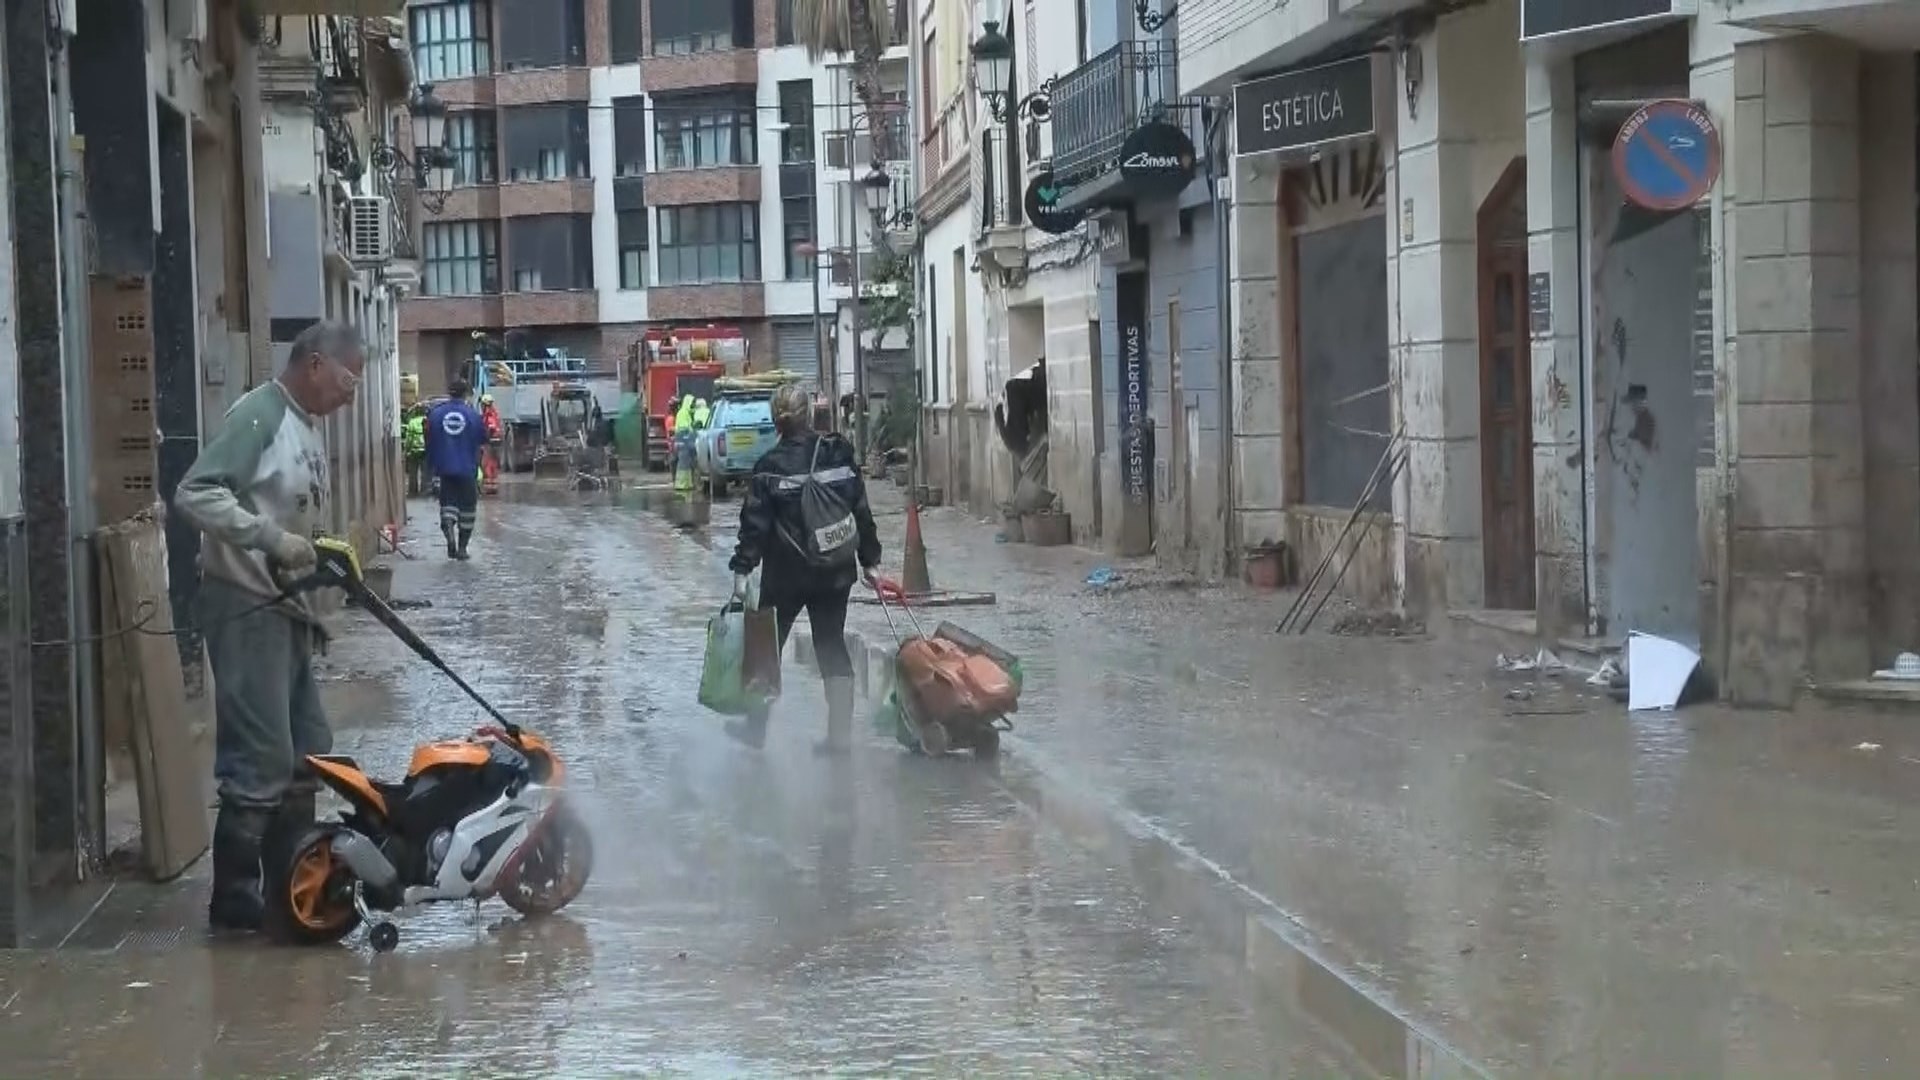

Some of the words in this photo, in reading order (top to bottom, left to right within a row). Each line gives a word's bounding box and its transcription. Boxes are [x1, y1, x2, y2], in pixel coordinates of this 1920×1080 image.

[1263, 88, 1344, 132] ESTÉTICA
[1127, 325, 1142, 424] DEPORTIVAS
[1129, 427, 1143, 503] PUESTAS
